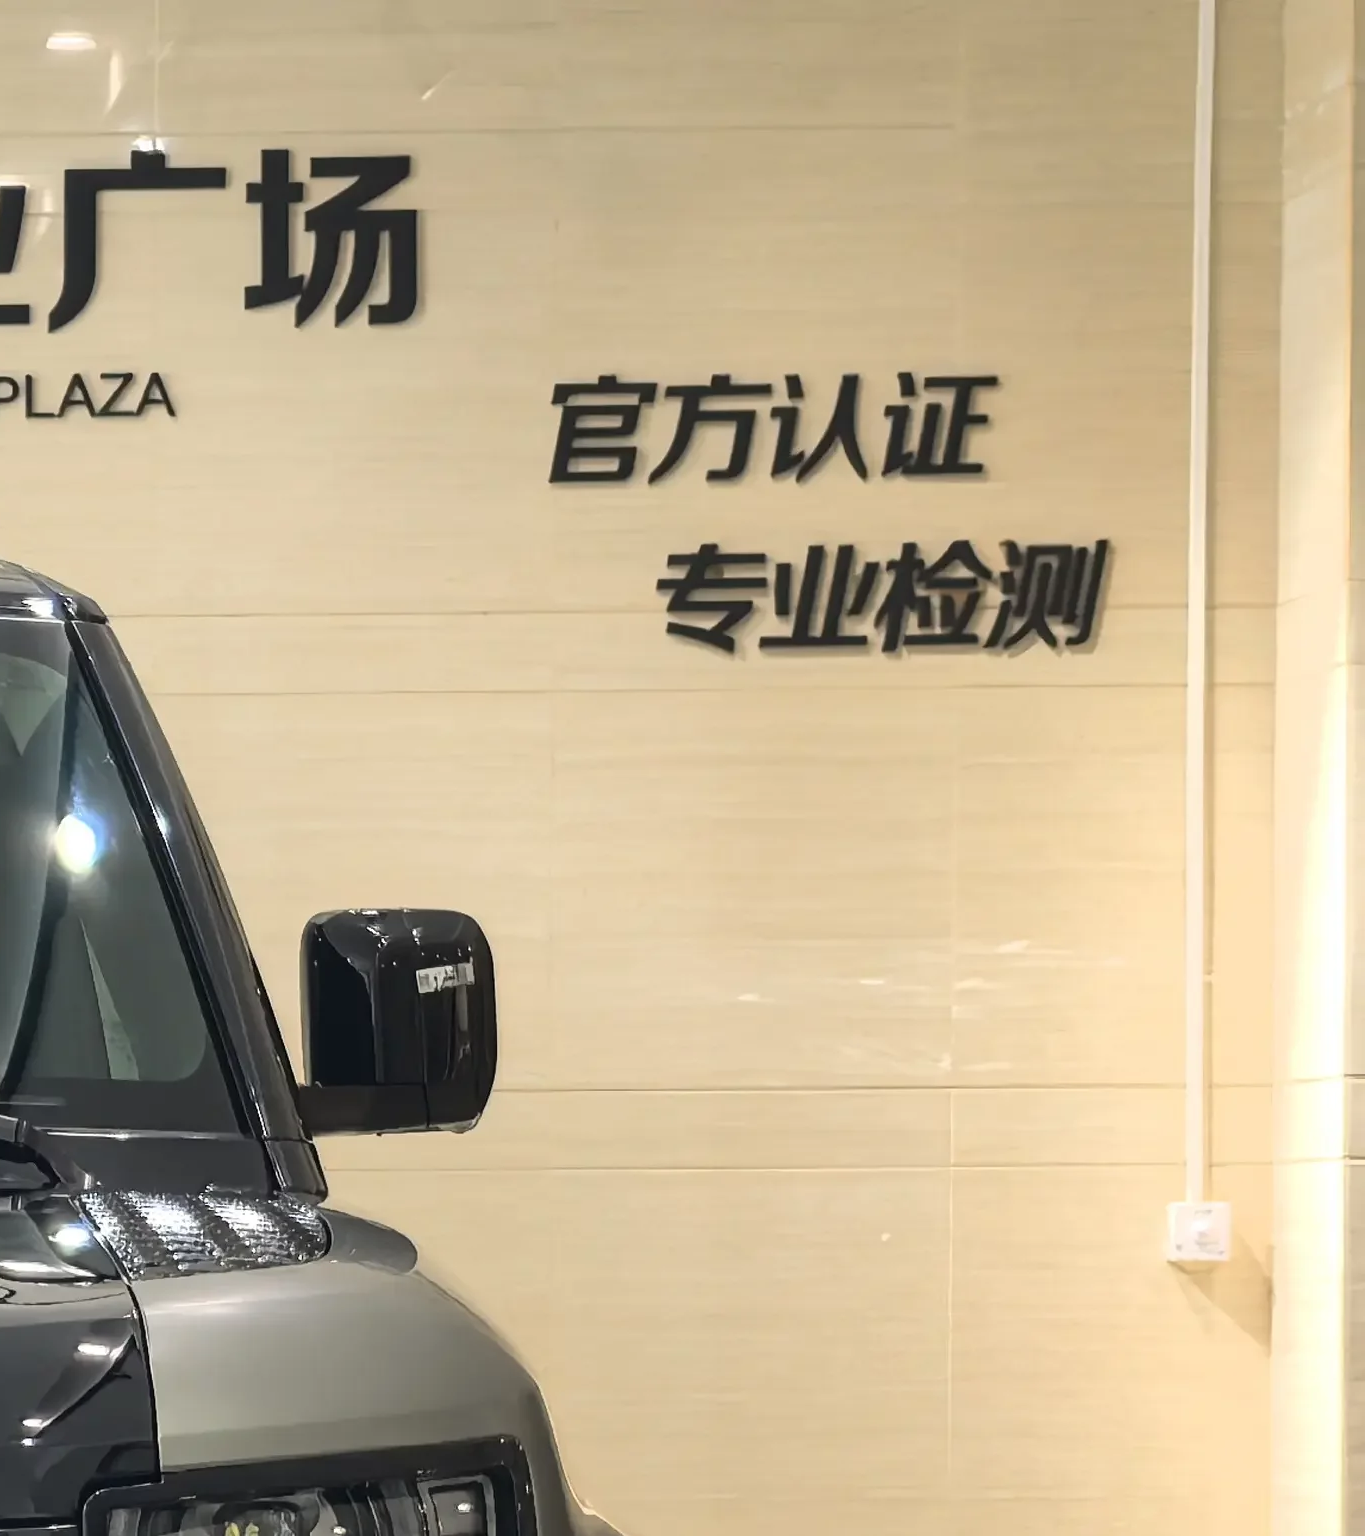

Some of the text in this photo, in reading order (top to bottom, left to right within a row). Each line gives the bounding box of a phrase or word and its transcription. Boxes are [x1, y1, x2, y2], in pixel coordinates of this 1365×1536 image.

[548, 372, 1000, 485] 官方认证
[656, 539, 1110, 654] 专业检测
